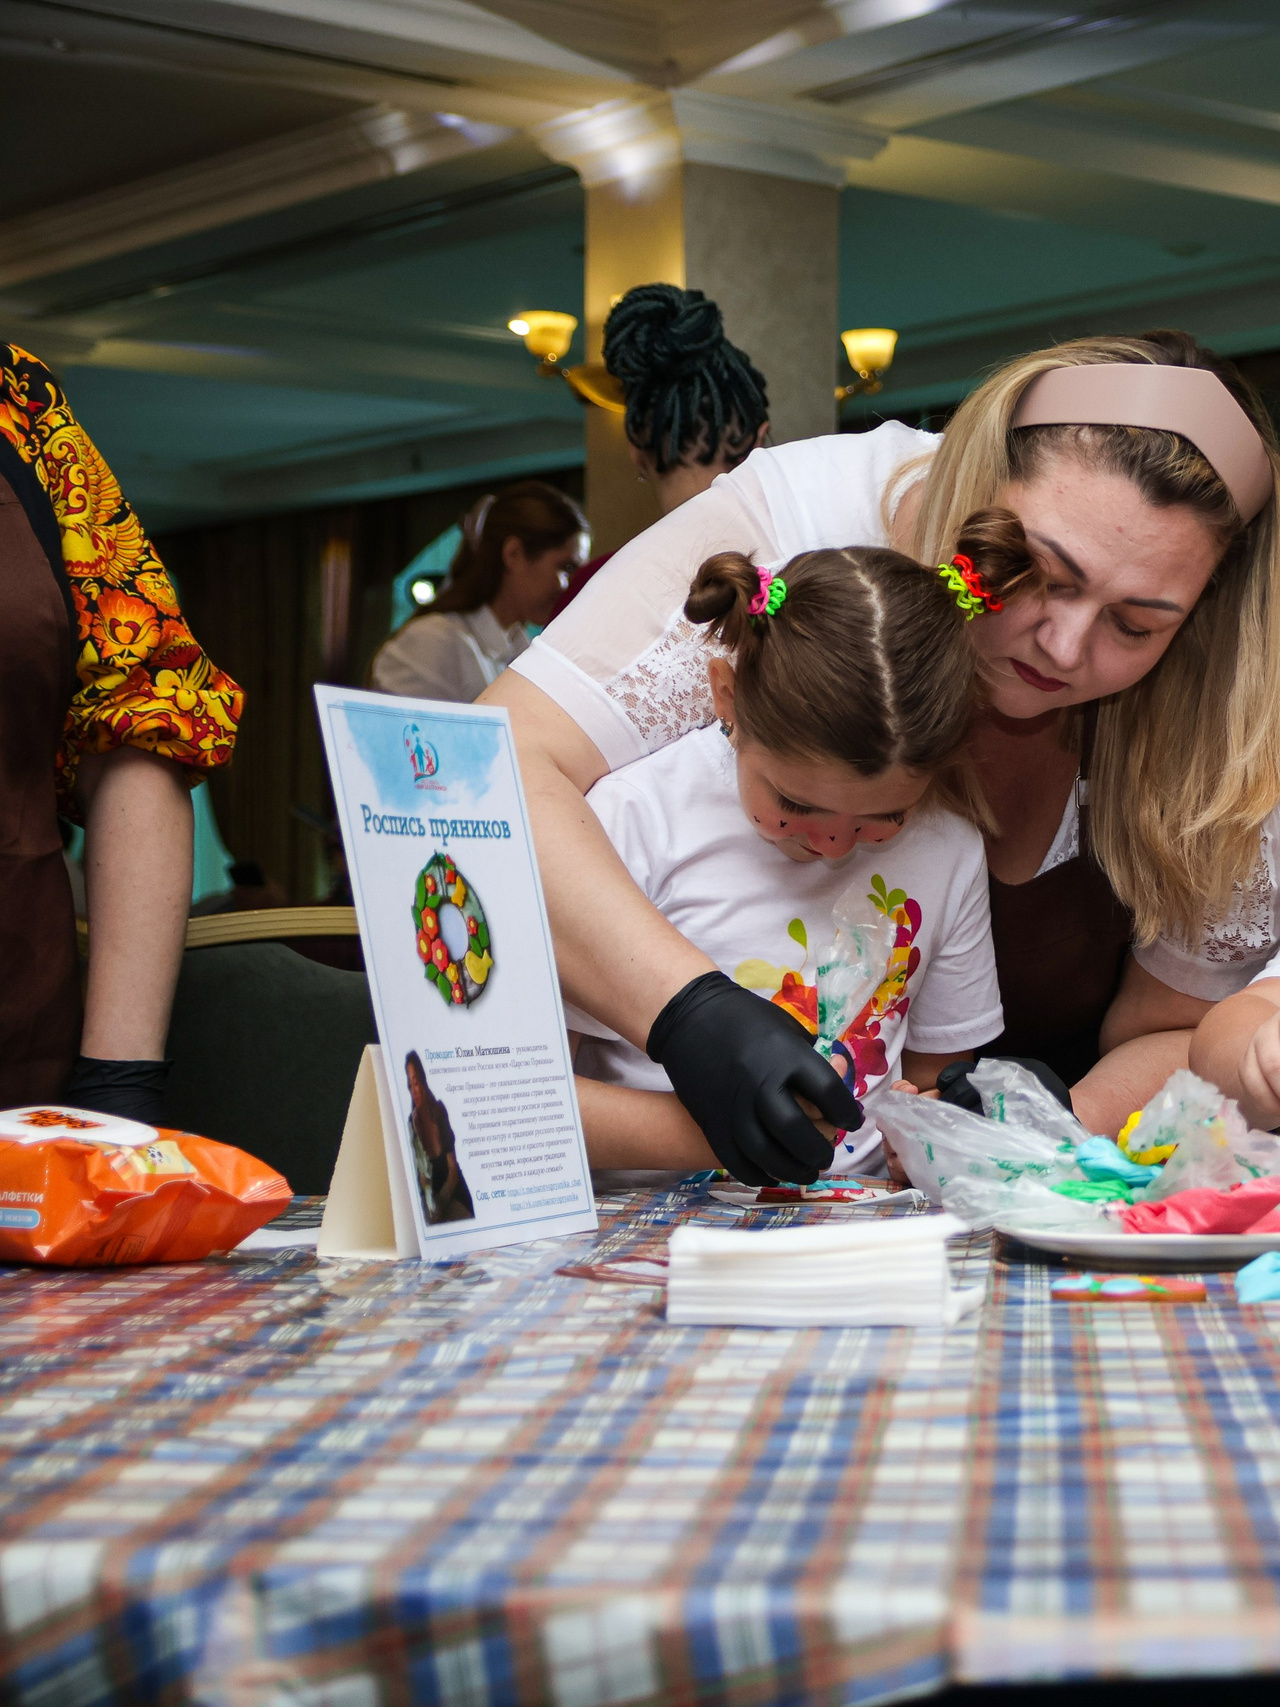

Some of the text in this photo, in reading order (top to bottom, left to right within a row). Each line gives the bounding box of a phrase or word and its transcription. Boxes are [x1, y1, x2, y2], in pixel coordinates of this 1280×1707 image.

[360, 803, 511, 846] Роспись пряников
[455, 1046, 474, 1058] Юлия
[474, 1046, 510, 1056] Матюшина
[516, 1044, 548, 1055] руководитель
[476, 1062, 494, 1070] России
[0, 1190, 44, 1203] ЛФЕТКИ
[476, 1189, 490, 1201] Соц.
